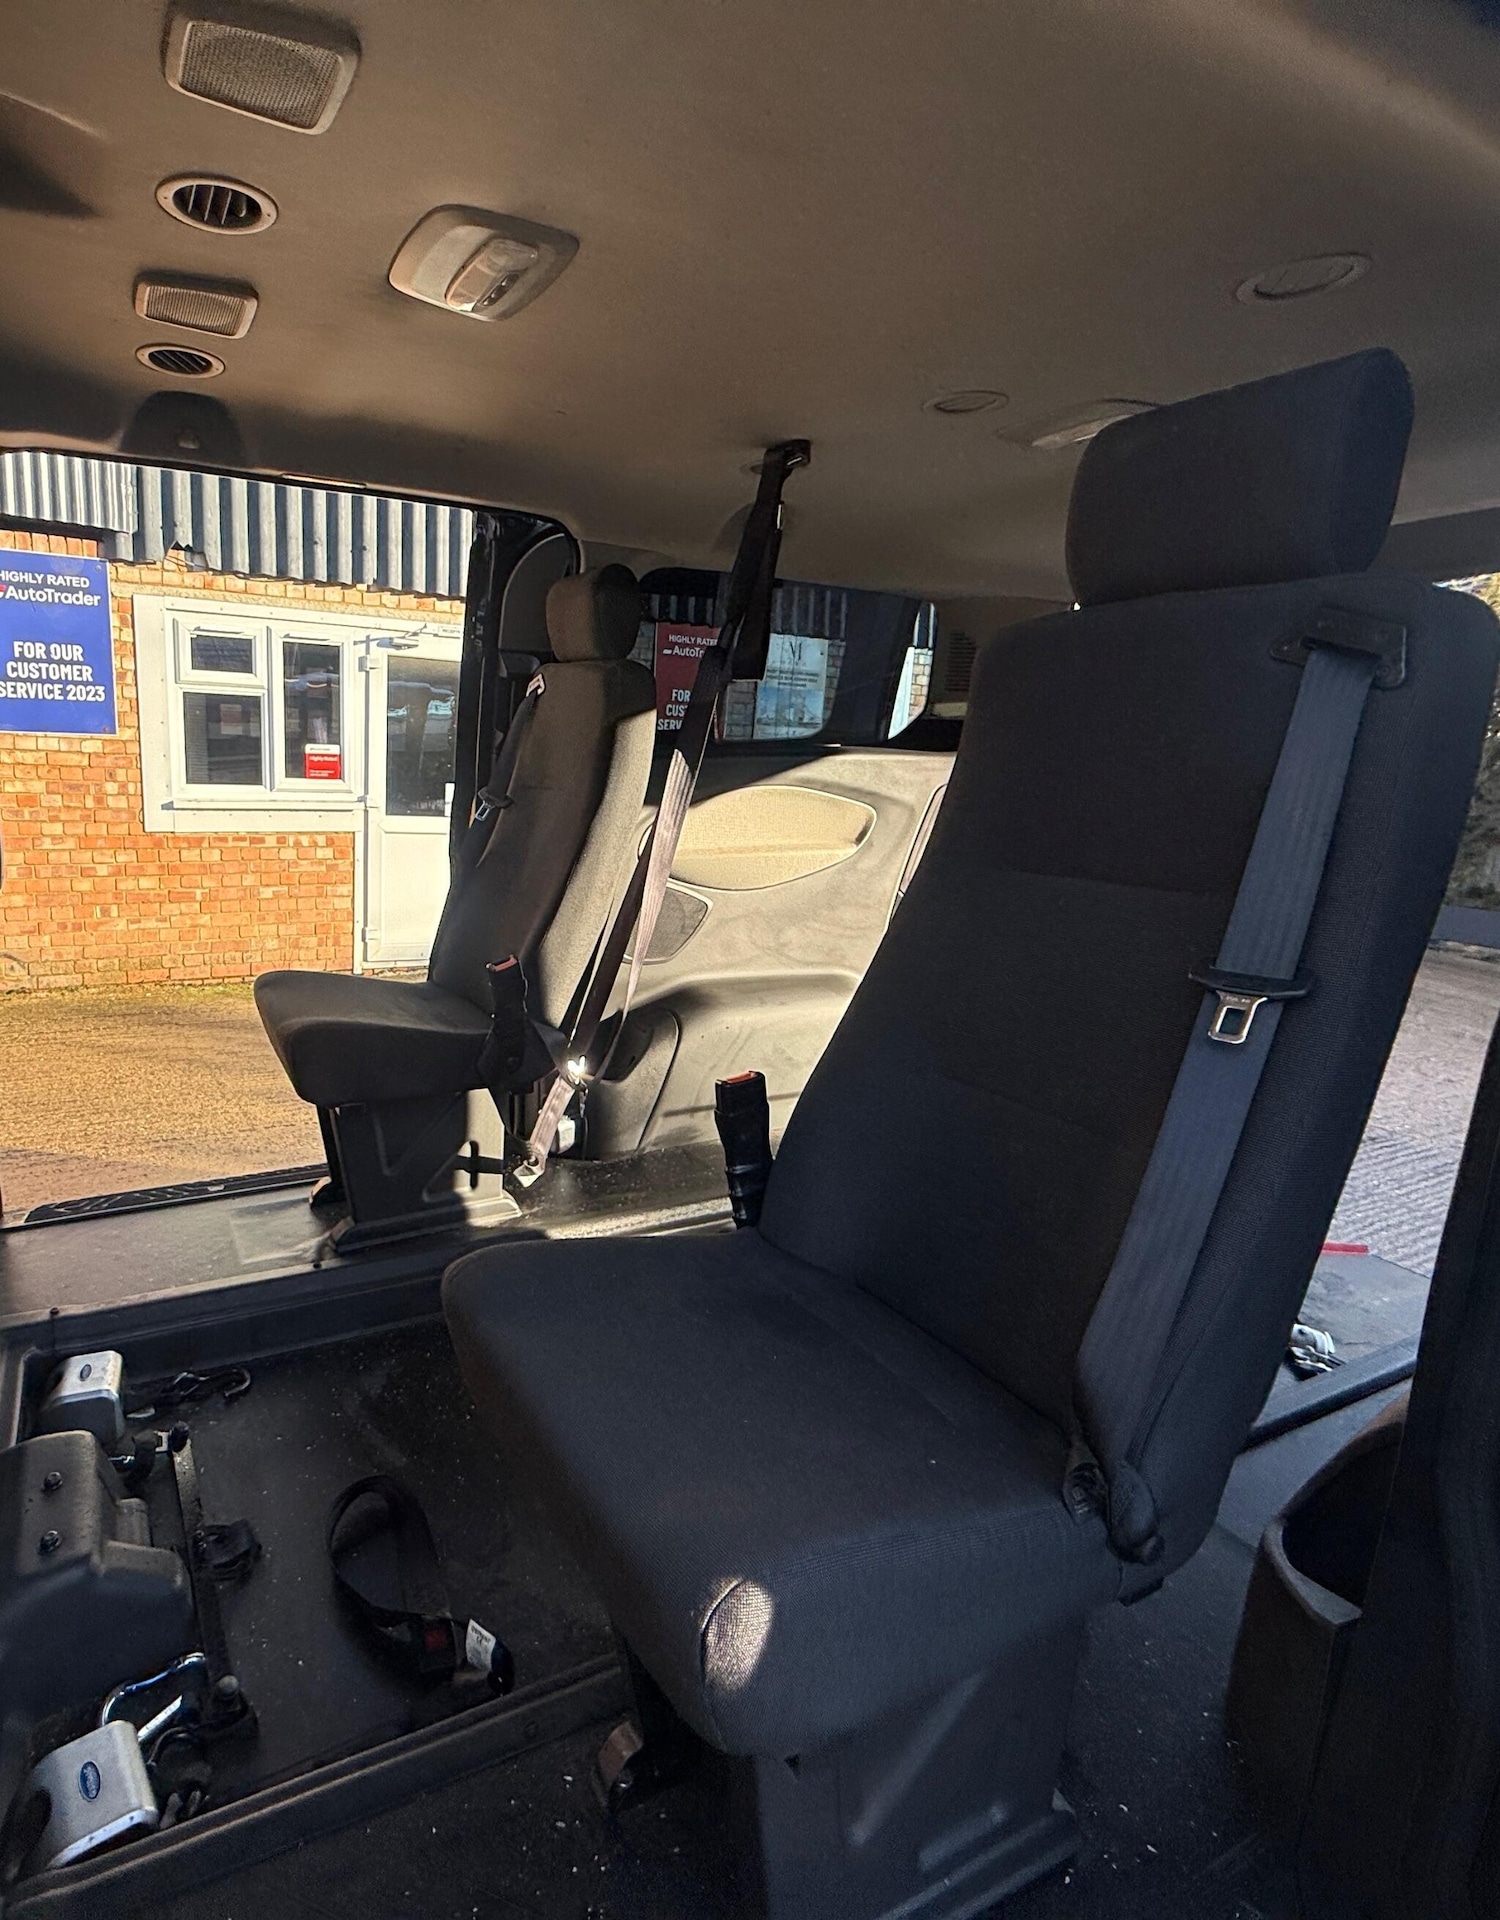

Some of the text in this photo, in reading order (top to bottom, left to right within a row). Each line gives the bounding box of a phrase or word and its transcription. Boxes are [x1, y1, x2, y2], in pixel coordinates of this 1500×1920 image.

[0, 570, 90, 588] HIGHLY RATED
[5, 585, 101, 606] AutoTrader
[669, 634, 695, 645] HIGHLY
[13, 641, 84, 662] FOR OUR
[6, 660, 93, 682] CUSTOMER
[0, 680, 106, 702] SERVICE 2023
[671, 689, 691, 702] FOR
[665, 703, 688, 717] CUS
[657, 718, 683, 731] SERV
